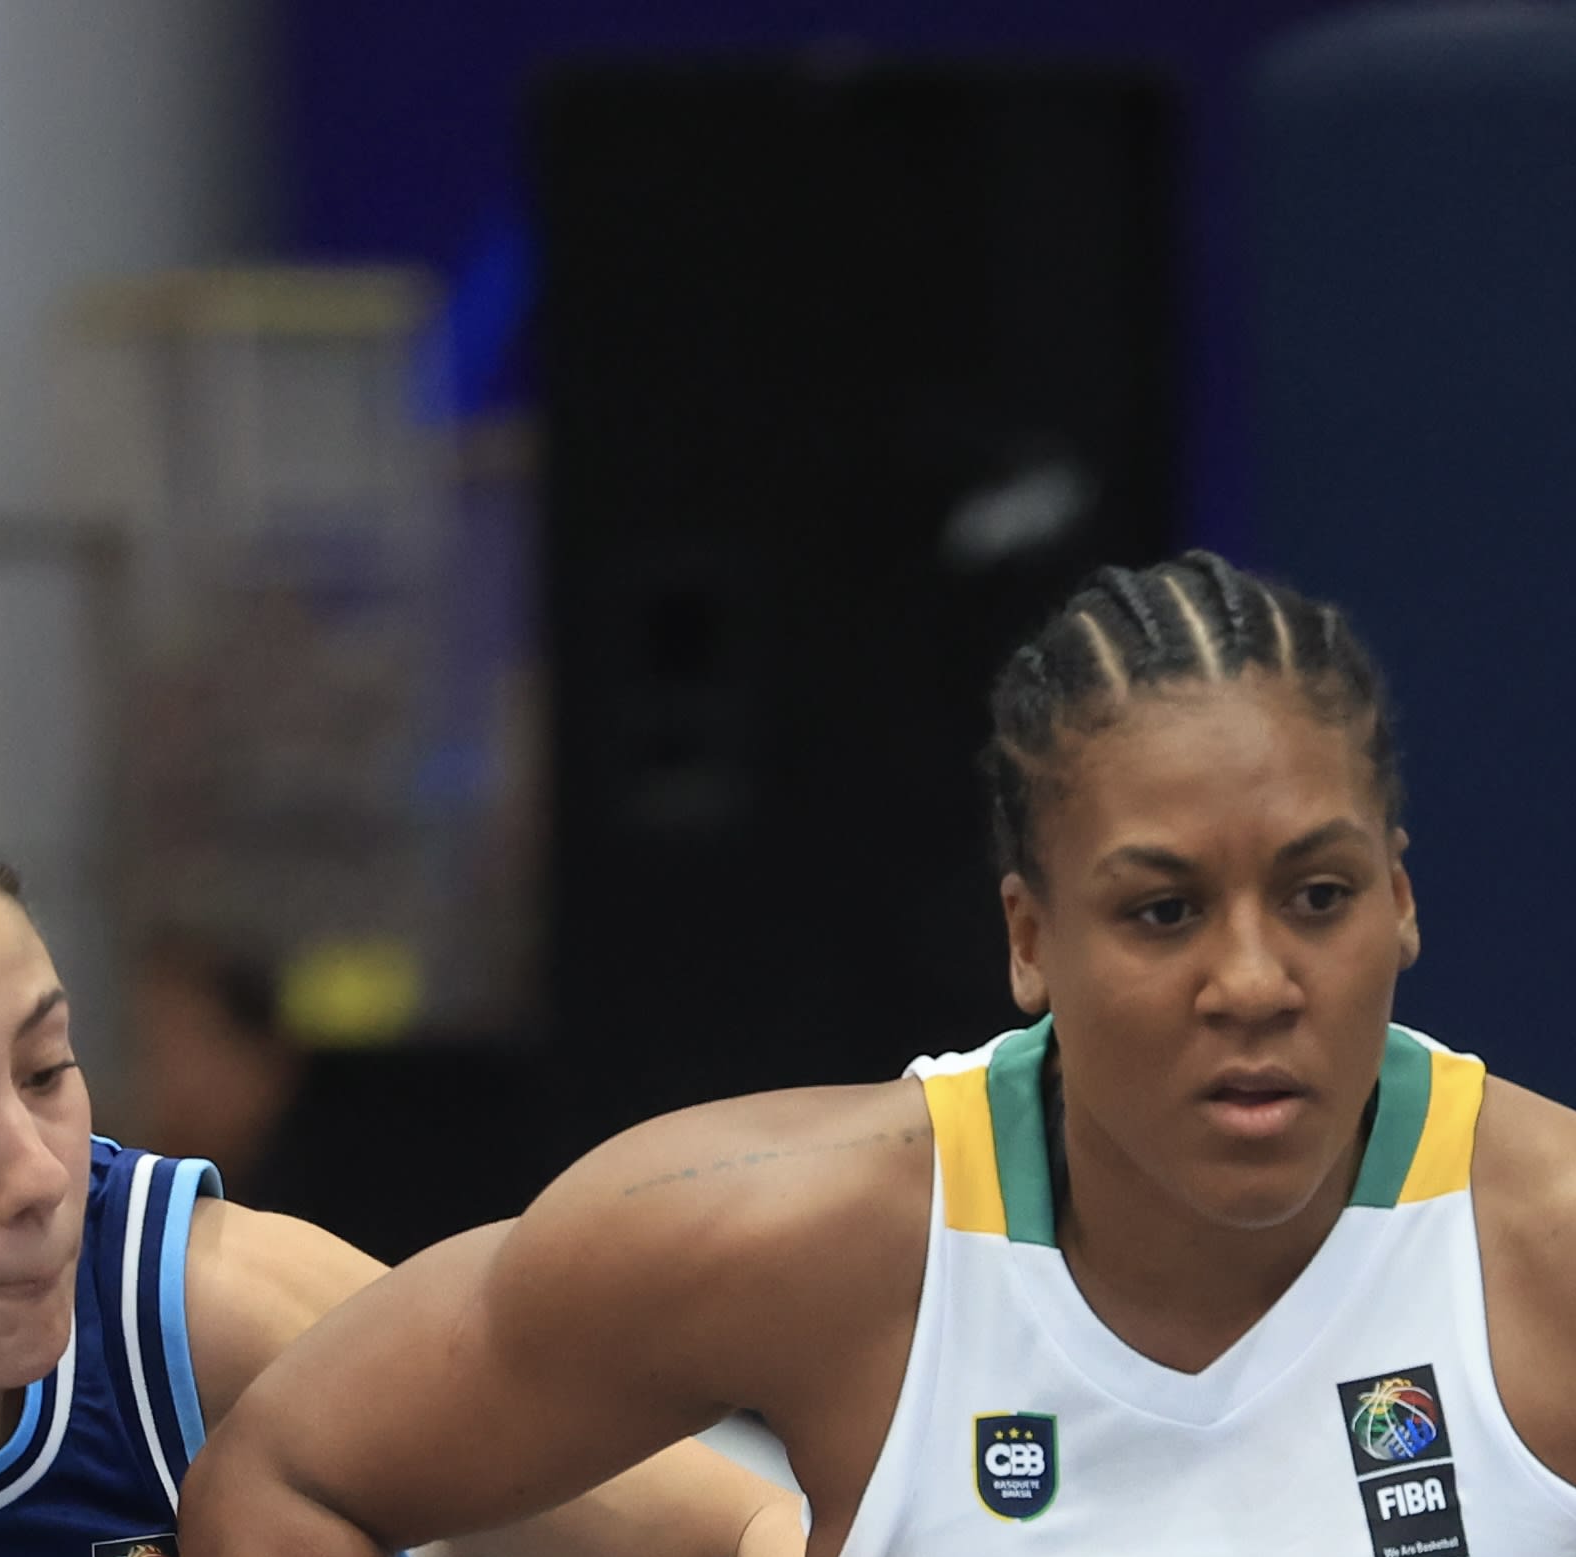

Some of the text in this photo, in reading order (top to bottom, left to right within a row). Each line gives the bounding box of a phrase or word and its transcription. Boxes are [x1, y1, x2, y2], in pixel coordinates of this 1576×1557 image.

[985, 1442, 1046, 1477] CBB
[1377, 1477, 1447, 1521] FIBA
[1400, 1544, 1416, 1557] Are
